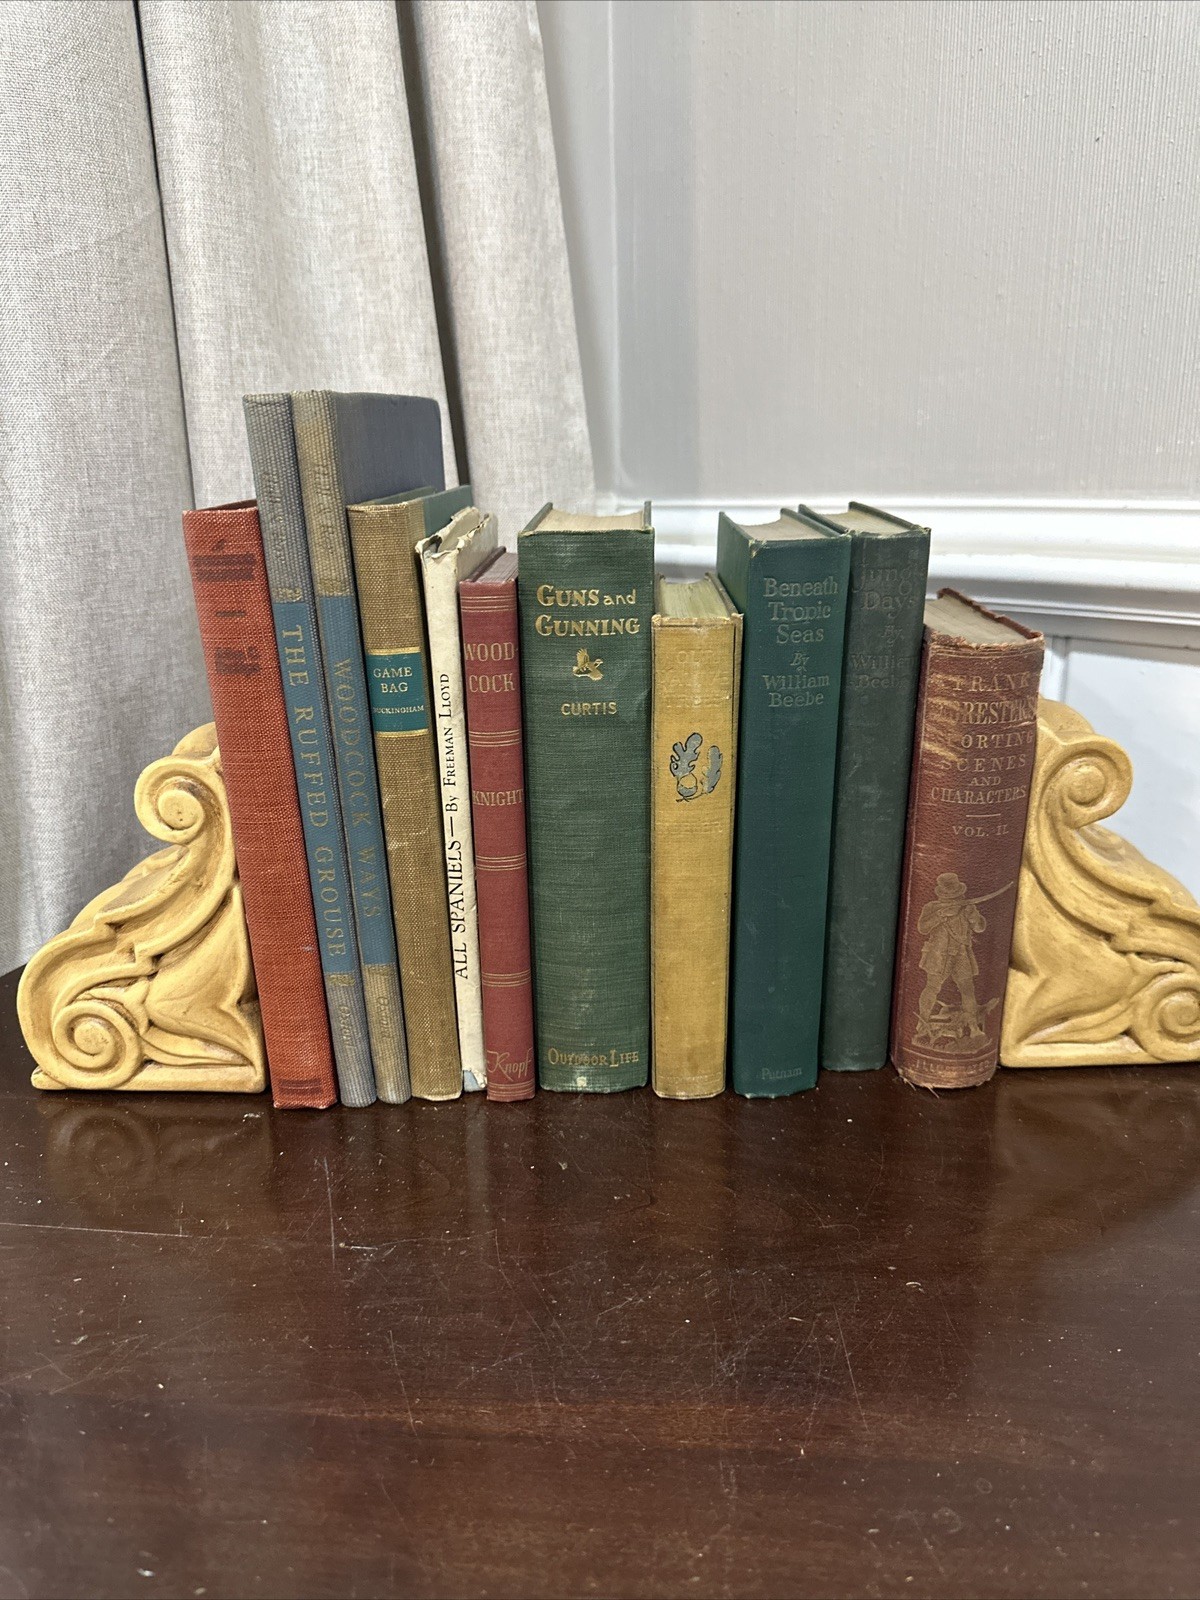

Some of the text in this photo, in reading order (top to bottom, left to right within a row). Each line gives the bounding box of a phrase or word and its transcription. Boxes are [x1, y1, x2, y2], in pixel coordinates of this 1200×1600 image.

[763, 576, 838, 597] Beneath
[603, 589, 636, 606] and
[768, 600, 831, 624] Tropic
[535, 614, 640, 637] GUNNING
[776, 624, 824, 644] Seas
[789, 651, 810, 673] By
[373, 666, 413, 680] GAME
[469, 673, 515, 693] COCK
[762, 674, 830, 691] William
[381, 682, 409, 693] BAG
[561, 702, 617, 717] CURTIS
[768, 691, 824, 708] Beebe
[934, 731, 1034, 750] ORTING
[282, 624, 346, 958] THE RUFFED GROUSE
[334, 657, 381, 918] WOODCOCK WAYS
[968, 776, 1001, 787] AND
[472, 789, 523, 806] KNIGHT
[930, 785, 1027, 805] CHARACTERS
[951, 825, 989, 837] VOL.
[448, 840, 466, 933] SPANIELS
[454, 942, 468, 979] ALL
[487, 1046, 533, 1082] Knopf
